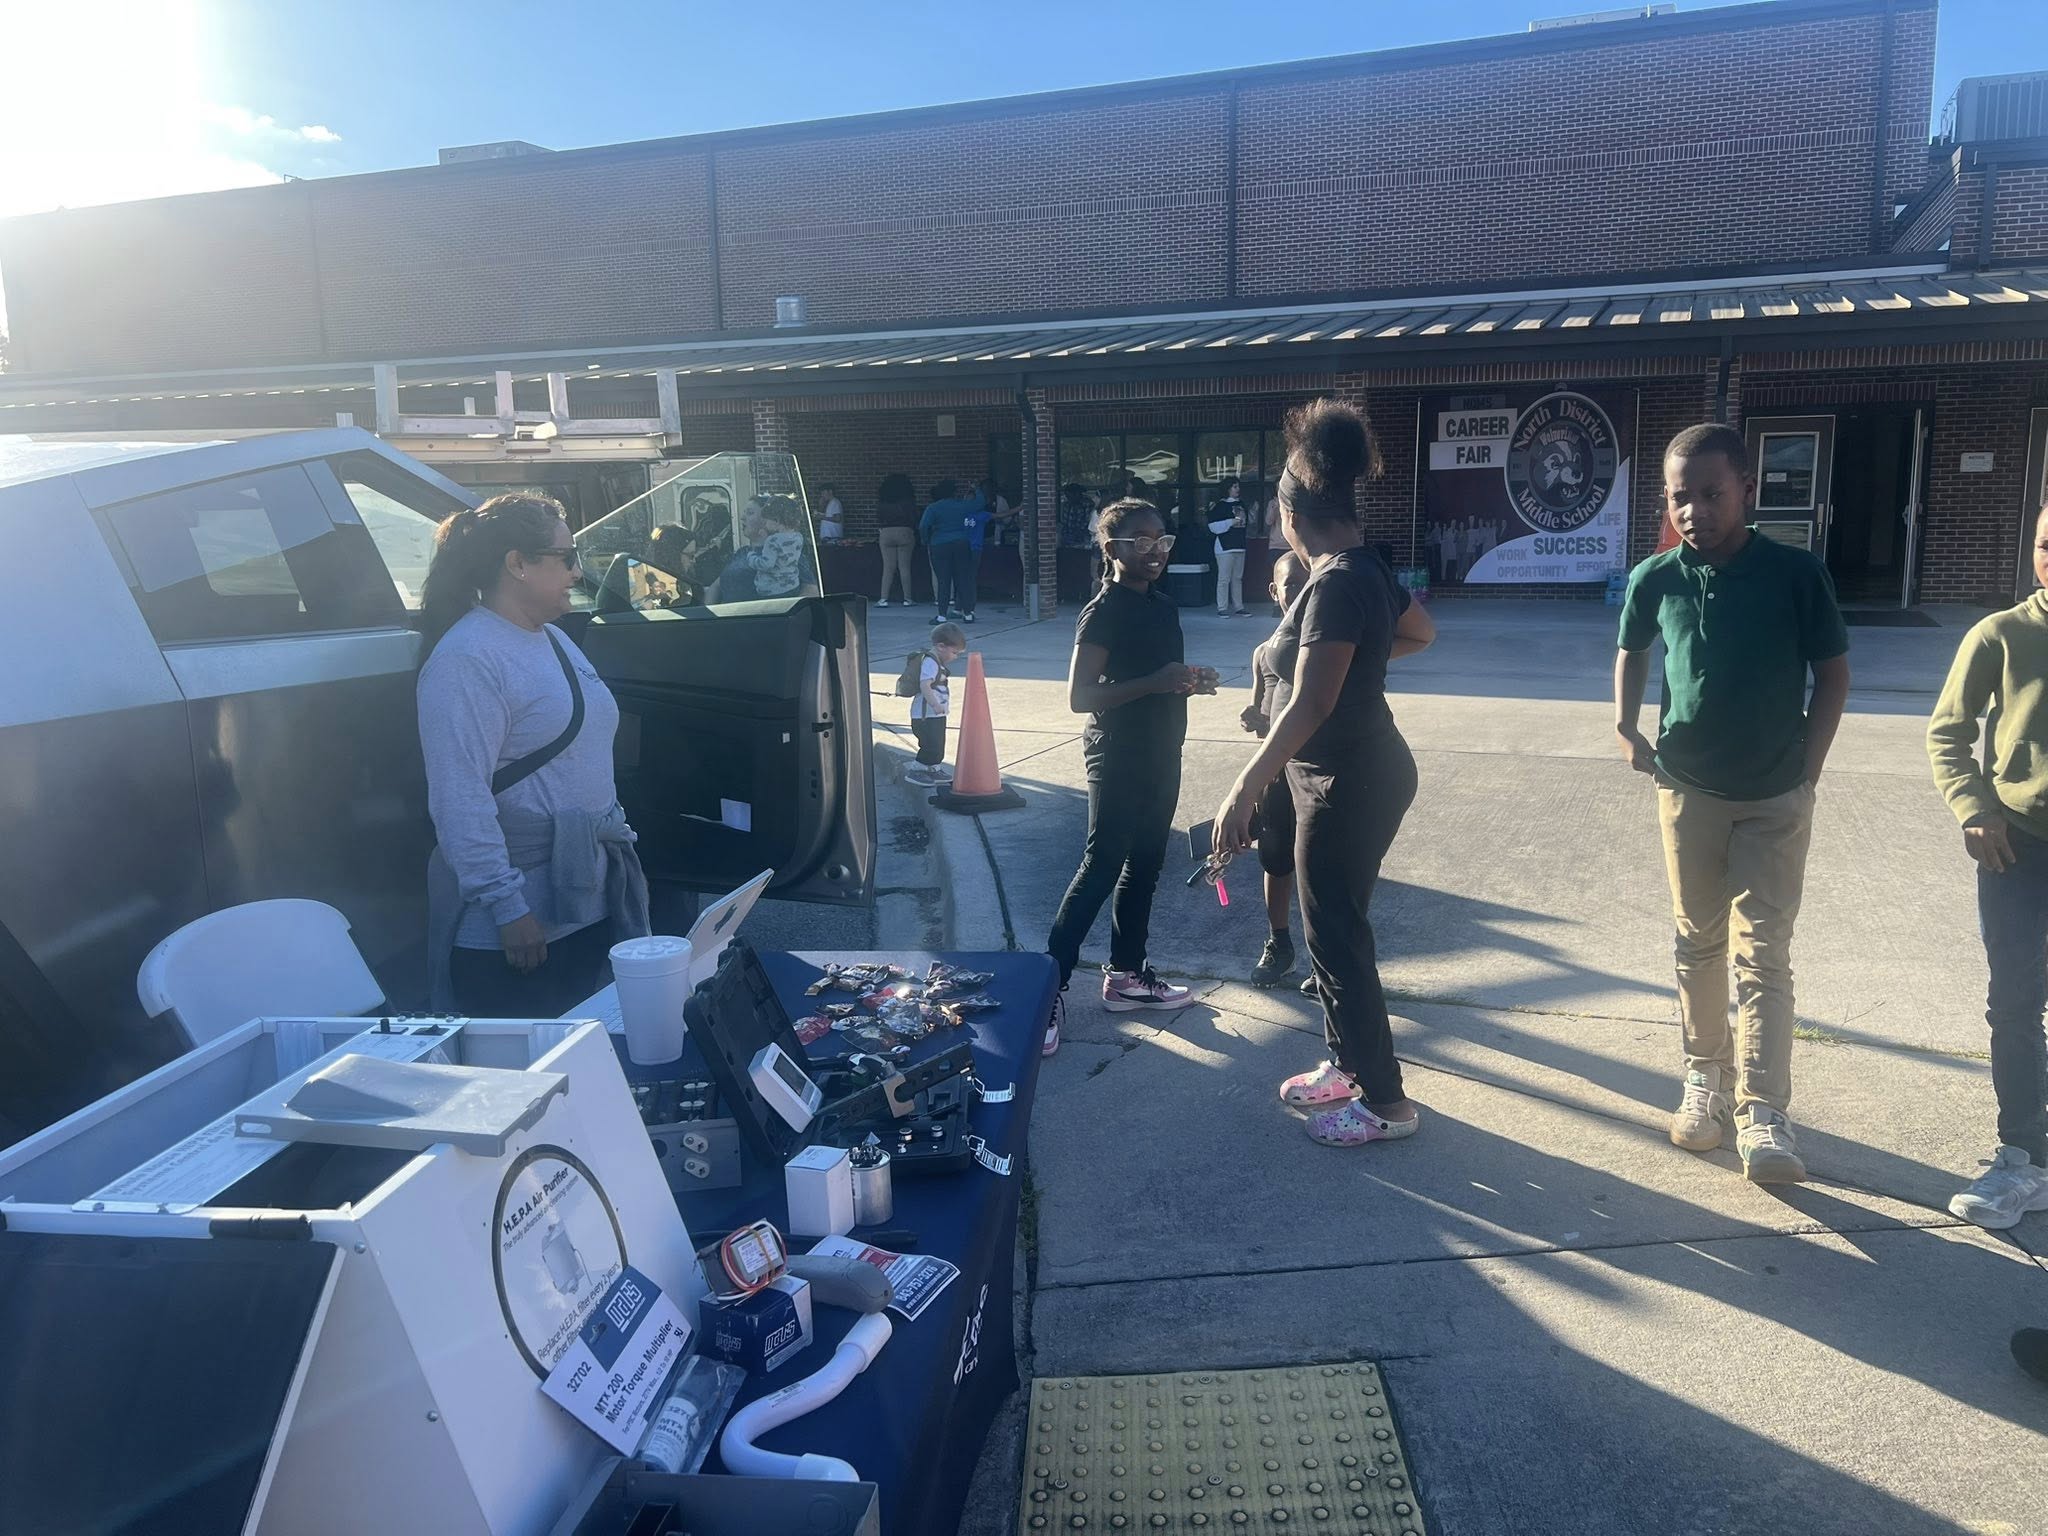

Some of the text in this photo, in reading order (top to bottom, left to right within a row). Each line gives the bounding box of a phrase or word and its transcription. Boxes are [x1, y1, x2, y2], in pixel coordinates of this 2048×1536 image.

[1446, 416, 1509, 438] CAREER
[1513, 400, 1607, 450] North District
[1456, 445, 1491, 464] FAIR
[1517, 484, 1606, 529] Middle School
[1597, 512, 1622, 526] LIFE
[1496, 548, 1528, 561] WORK
[1533, 536, 1608, 556] SUCCESS
[1497, 565, 1569, 578] OPPORTUNITY
[1576, 561, 1612, 572] EFFORT
[532, 1191, 544, 1208] Air
[542, 1167, 569, 1196] Purifier
[537, 1331, 561, 1359] Replace
[589, 1281, 604, 1300] every
[605, 1262, 621, 1287] years
[567, 1361, 592, 1393] 32702
[605, 1319, 673, 1424] Motor Torque Multiplier
[608, 1373, 624, 1395] 200
